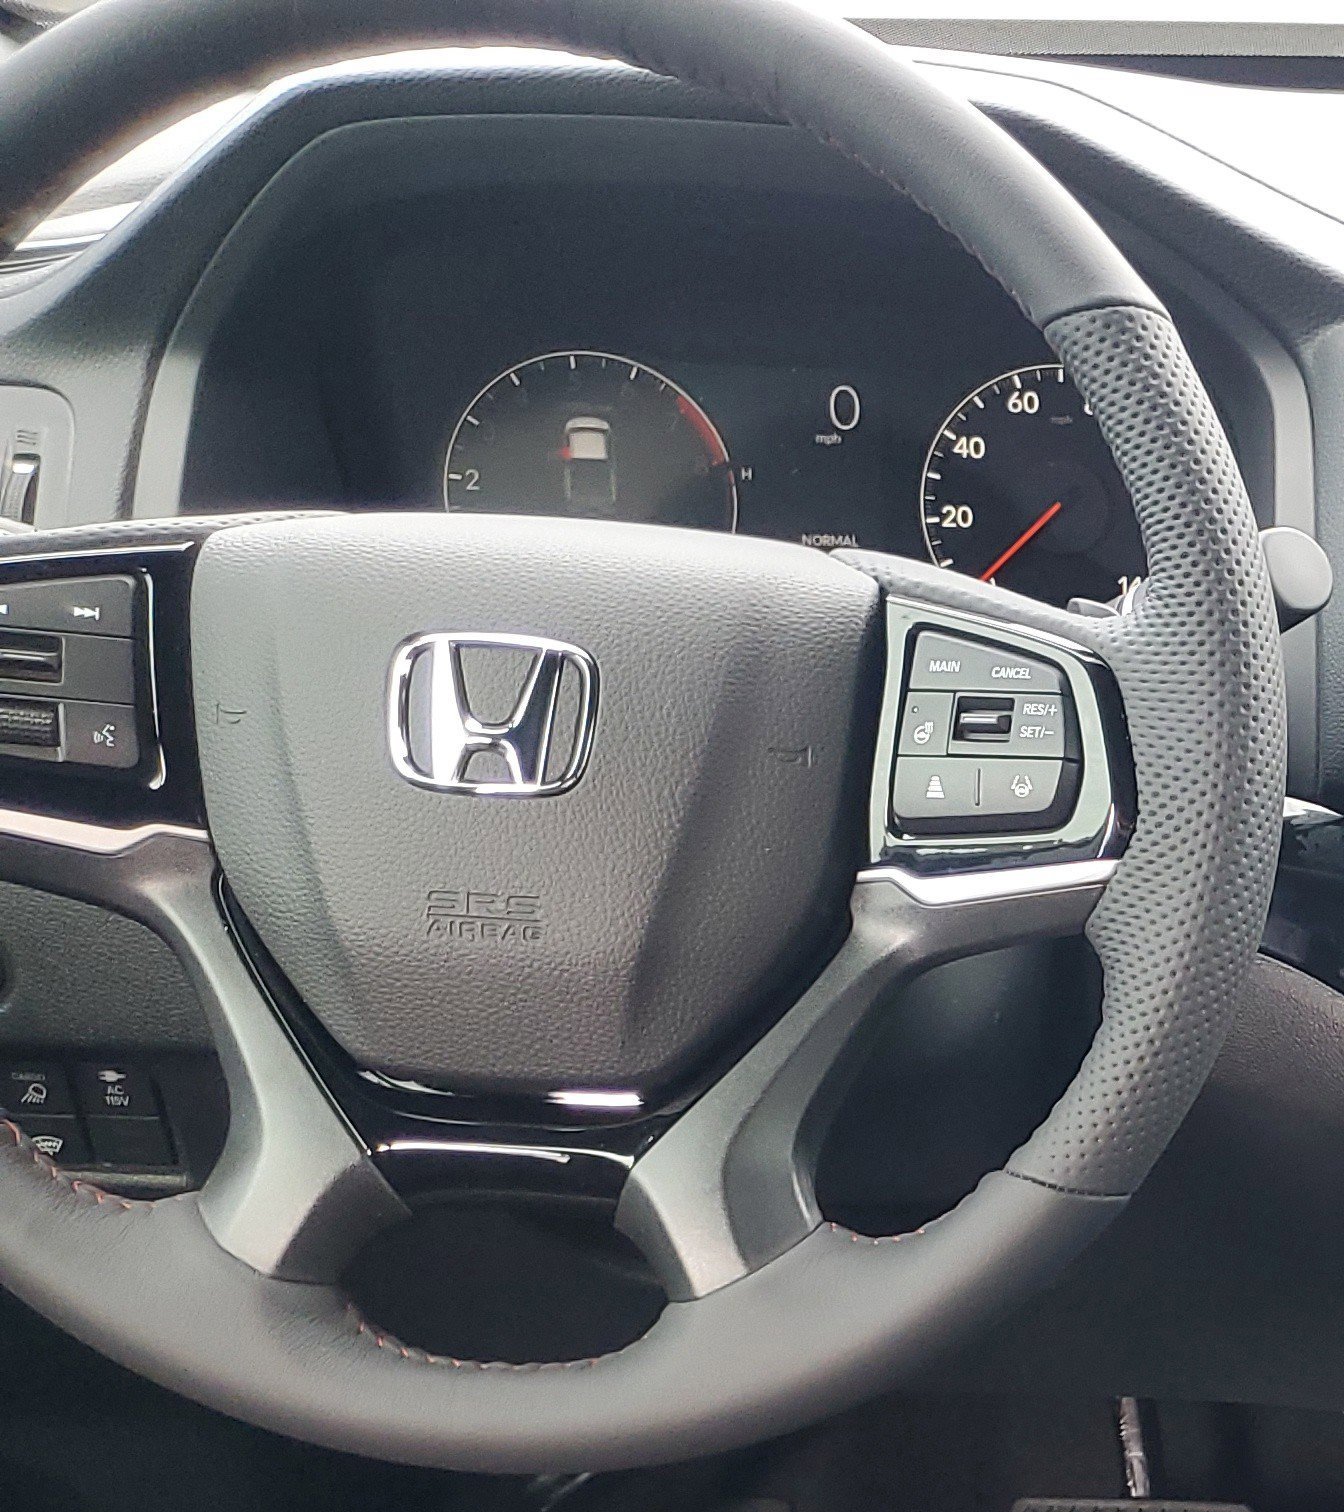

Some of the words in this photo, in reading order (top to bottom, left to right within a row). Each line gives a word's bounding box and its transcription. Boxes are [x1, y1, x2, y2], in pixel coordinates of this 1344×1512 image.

[830, 384, 860, 430] 0
[1006, 391, 1040, 414] 60
[952, 436, 986, 459] 40
[940, 504, 974, 528] 20
[802, 533, 858, 548] NORMAL
[929, 660, 960, 672] MAIN
[991, 666, 1032, 680] CANCEL
